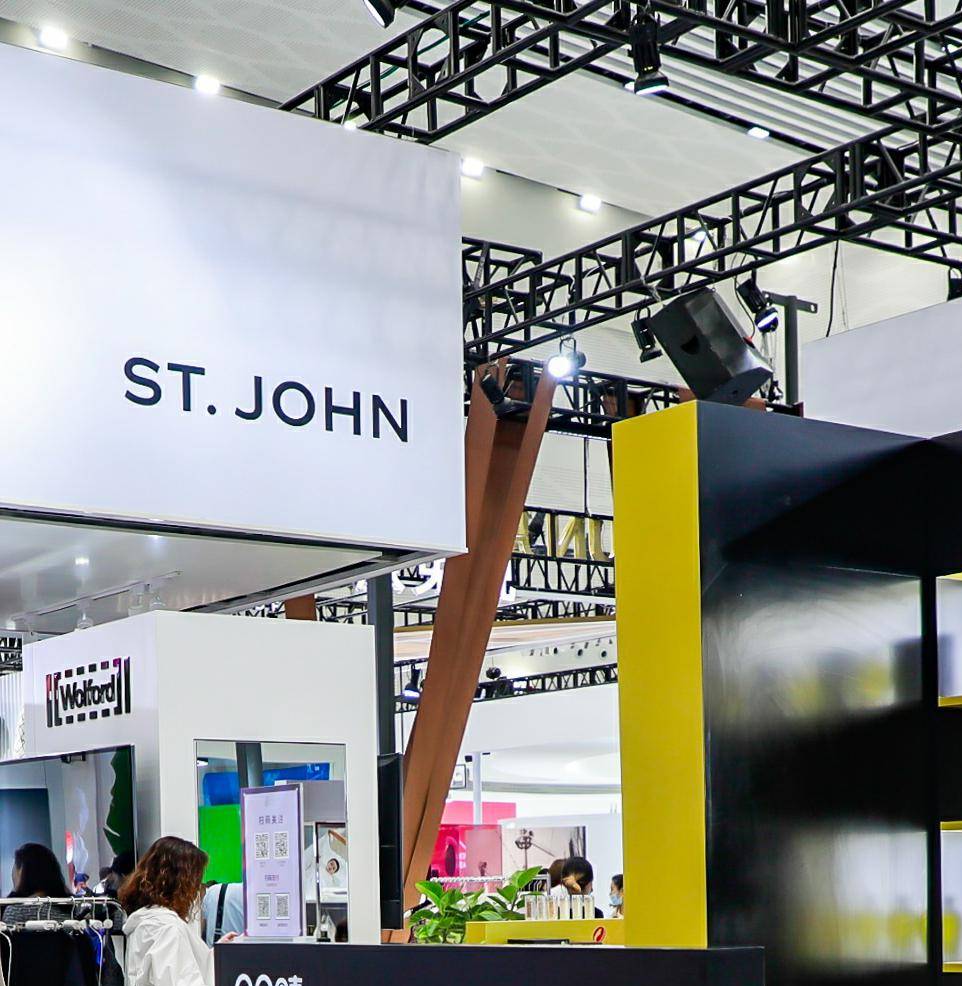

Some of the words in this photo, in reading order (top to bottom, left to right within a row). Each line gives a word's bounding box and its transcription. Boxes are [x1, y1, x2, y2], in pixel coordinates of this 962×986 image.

[123, 357, 217, 416] ST.
[234, 375, 410, 444] JOHN
[59, 674, 116, 711] Wolford
